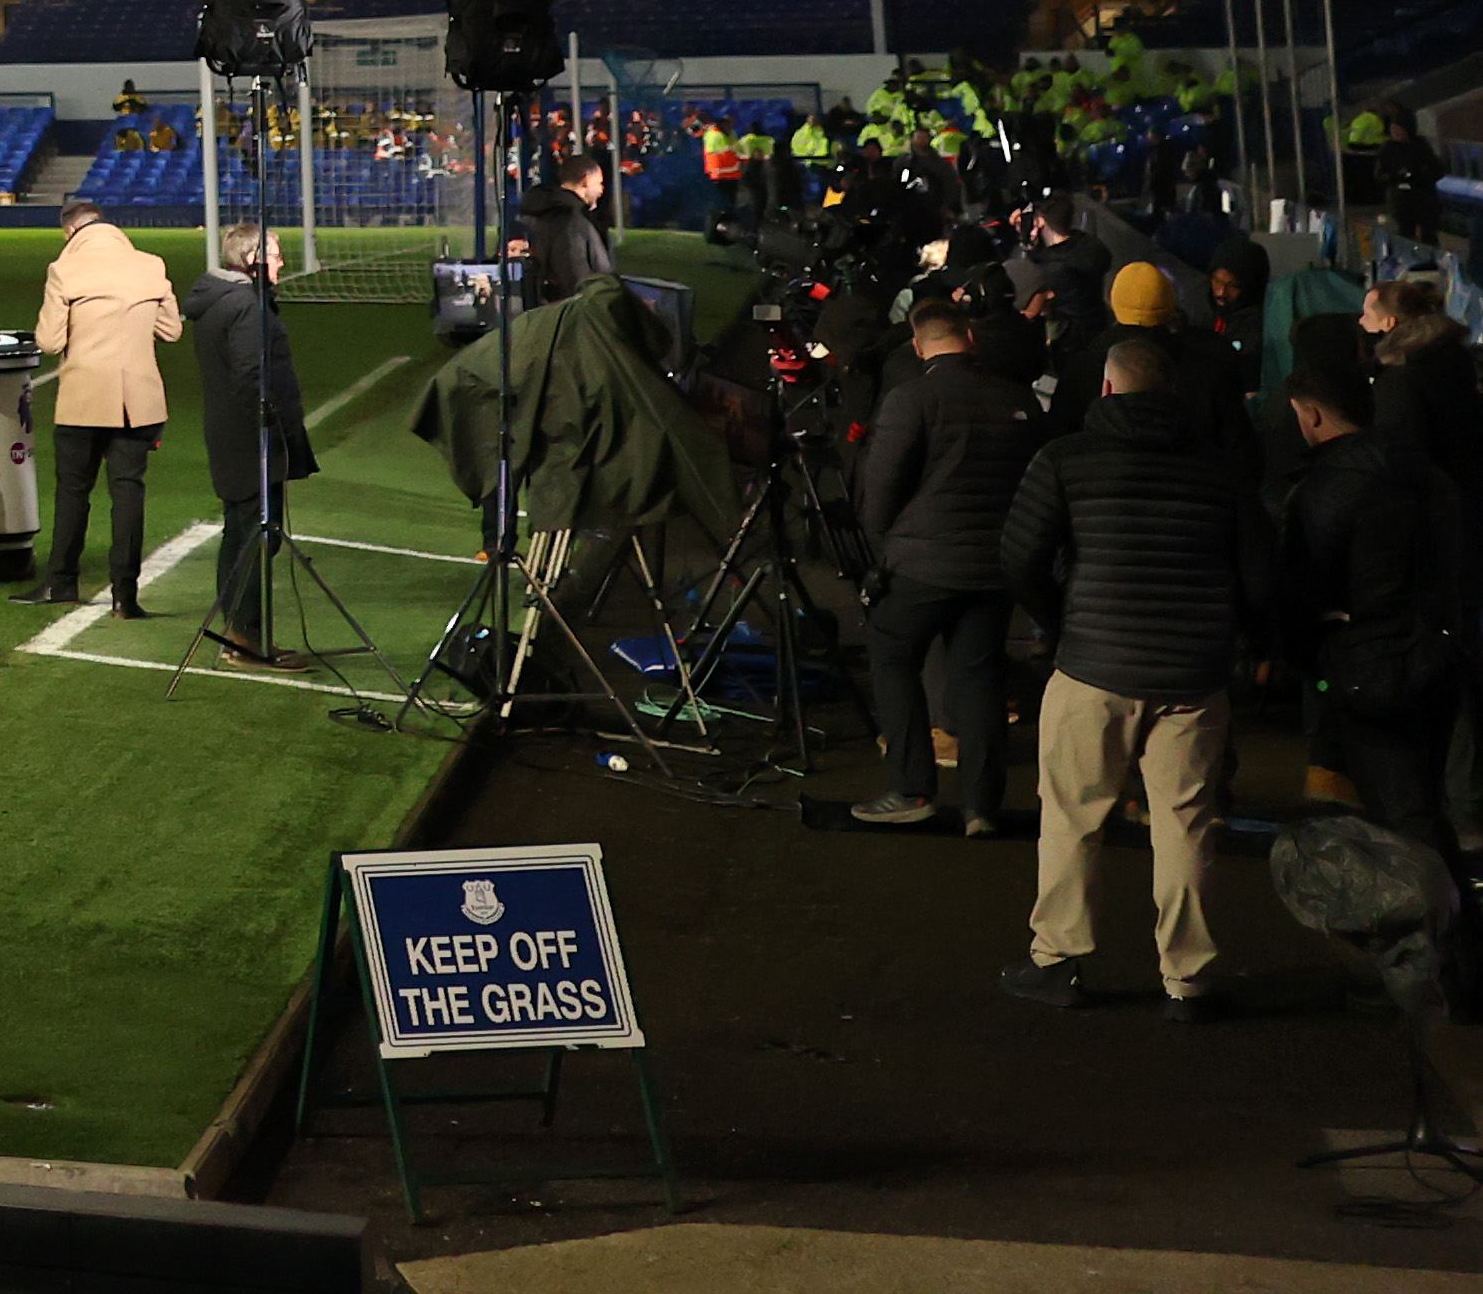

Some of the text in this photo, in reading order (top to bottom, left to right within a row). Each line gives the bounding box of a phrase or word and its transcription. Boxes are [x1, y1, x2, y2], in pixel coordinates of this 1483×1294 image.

[405, 929, 578, 976] KEEP OFF
[398, 979, 608, 1027] THE GRASS
